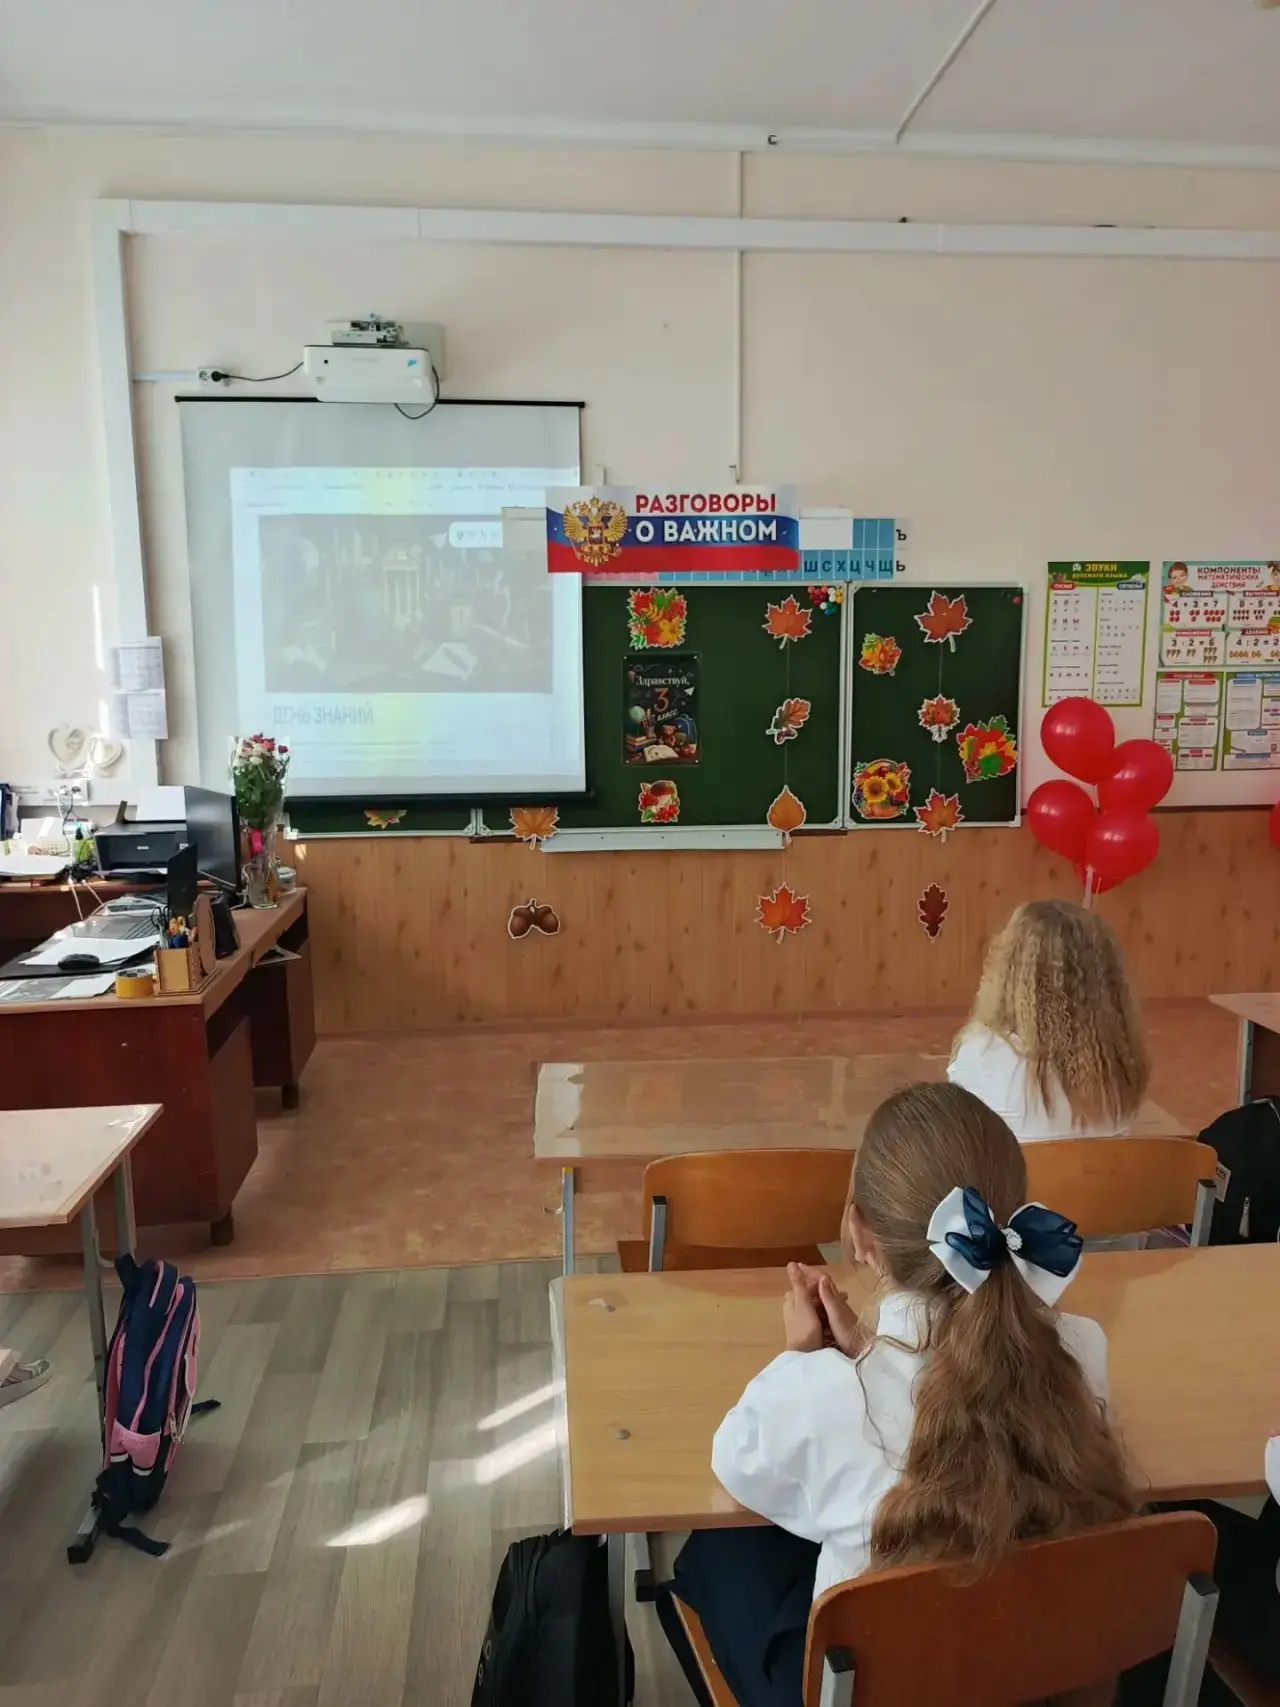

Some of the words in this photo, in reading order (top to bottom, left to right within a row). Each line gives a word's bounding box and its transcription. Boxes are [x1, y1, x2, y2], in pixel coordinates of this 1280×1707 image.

[635, 493, 777, 513] РАЗГОВОРЫ
[635, 520, 655, 543] О
[664, 518, 777, 543] ВАЖНОМ
[1085, 563, 1117, 572] ЗВУКИ
[1197, 566, 1261, 574] КОМПОНЕНТЫ
[636, 675, 690, 688] Здравствуй,
[653, 687, 669, 712] 3
[273, 706, 310, 726] ДЕНЬ
[314, 701, 373, 725] ЗНАНИЙ
